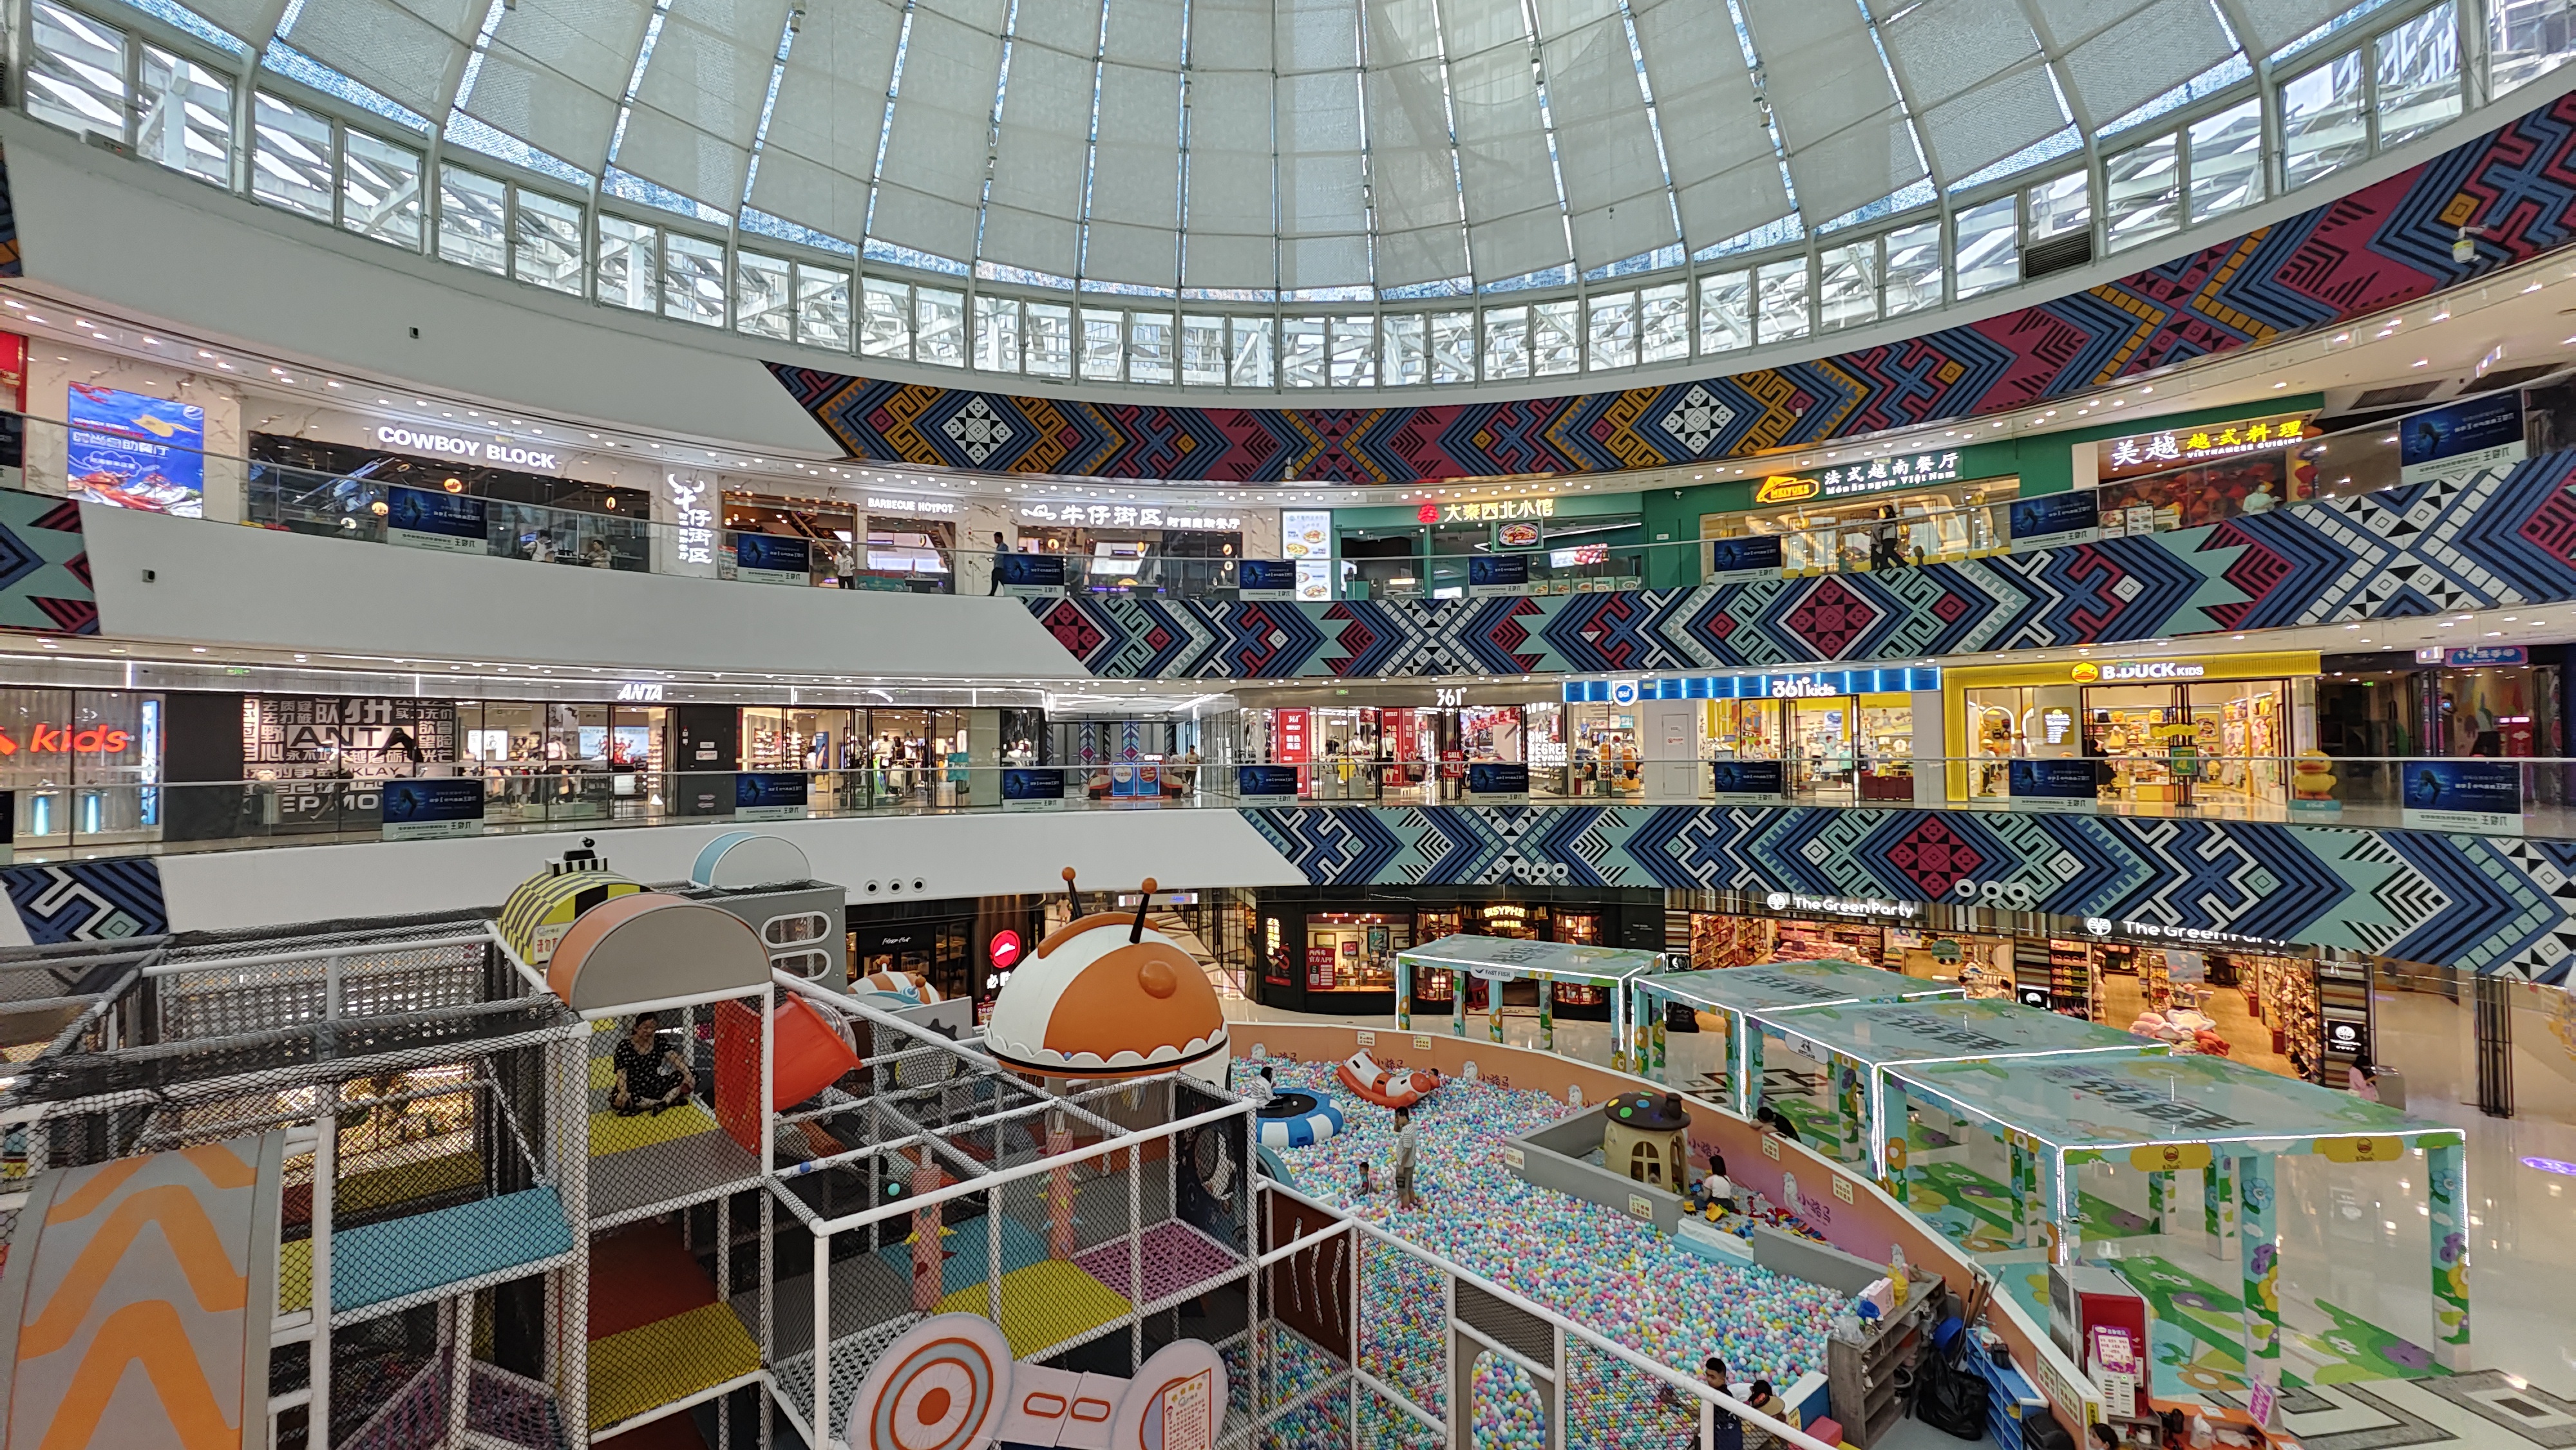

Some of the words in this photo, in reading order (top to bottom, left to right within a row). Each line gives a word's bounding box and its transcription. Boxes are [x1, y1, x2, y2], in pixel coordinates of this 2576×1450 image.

[2186, 420, 2302, 450] 越式料理
[377, 426, 480, 457] COWBOY
[486, 444, 556, 469] BLOCK
[2112, 431, 2181, 467] 美越
[2186, 444, 2254, 459] VIETNAMESE
[1824, 451, 1959, 485] 法式越南餐厅
[1929, 471, 1956, 480] Nam
[867, 497, 916, 511] BARBECUE
[918, 502, 954, 514] HOTPOT
[1060, 504, 1164, 527] 牛仔街区
[1443, 498, 1555, 523] 大秦西北小馆
[668, 473, 713, 564] 牛仔街区
[2102, 663, 2175, 680] B.DUCK
[2177, 666, 2204, 677] KIDS
[617, 683, 663, 701] ANTA
[1435, 686, 1468, 707] 361°
[1805, 684, 1837, 697] kids
[262, 712, 312, 724] 去打破
[30, 724, 133, 753] kids
[289, 726, 413, 748] ANTA
[1528, 731, 1548, 743] ONE
[1527, 742, 1567, 756] DEGREE
[352, 767, 401, 777] KLAY
[1484, 905, 1526, 918] SISYPHE
[1794, 897, 1822, 910] The
[1822, 898, 1870, 914] Green
[1871, 902, 1915, 919] Party
[2123, 921, 2160, 937] The
[2163, 925, 2228, 941] Green
